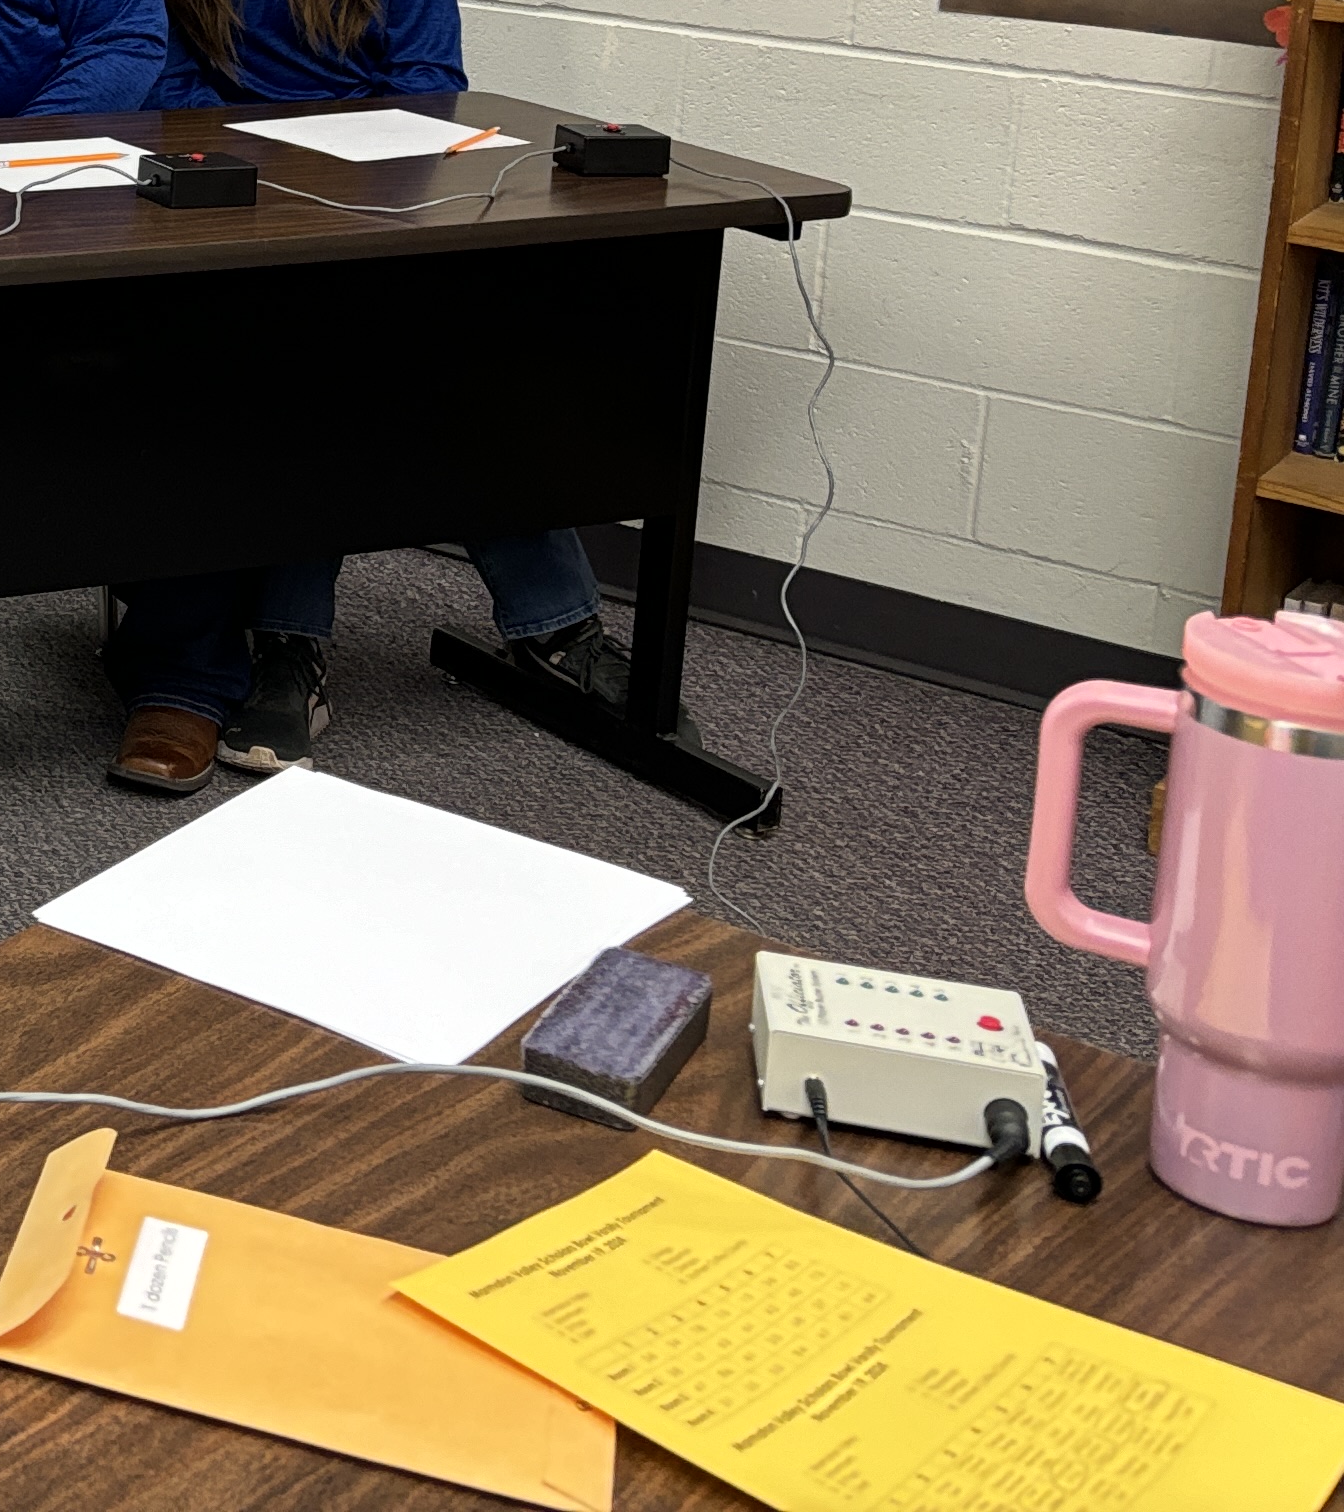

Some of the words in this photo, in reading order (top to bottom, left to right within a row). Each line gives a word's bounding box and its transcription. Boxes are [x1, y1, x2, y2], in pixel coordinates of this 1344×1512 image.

[1317, 280, 1332, 300] KIT'S
[1309, 302, 1328, 355] WILDERNESS
[1176, 1112, 1310, 1189] RTIC
